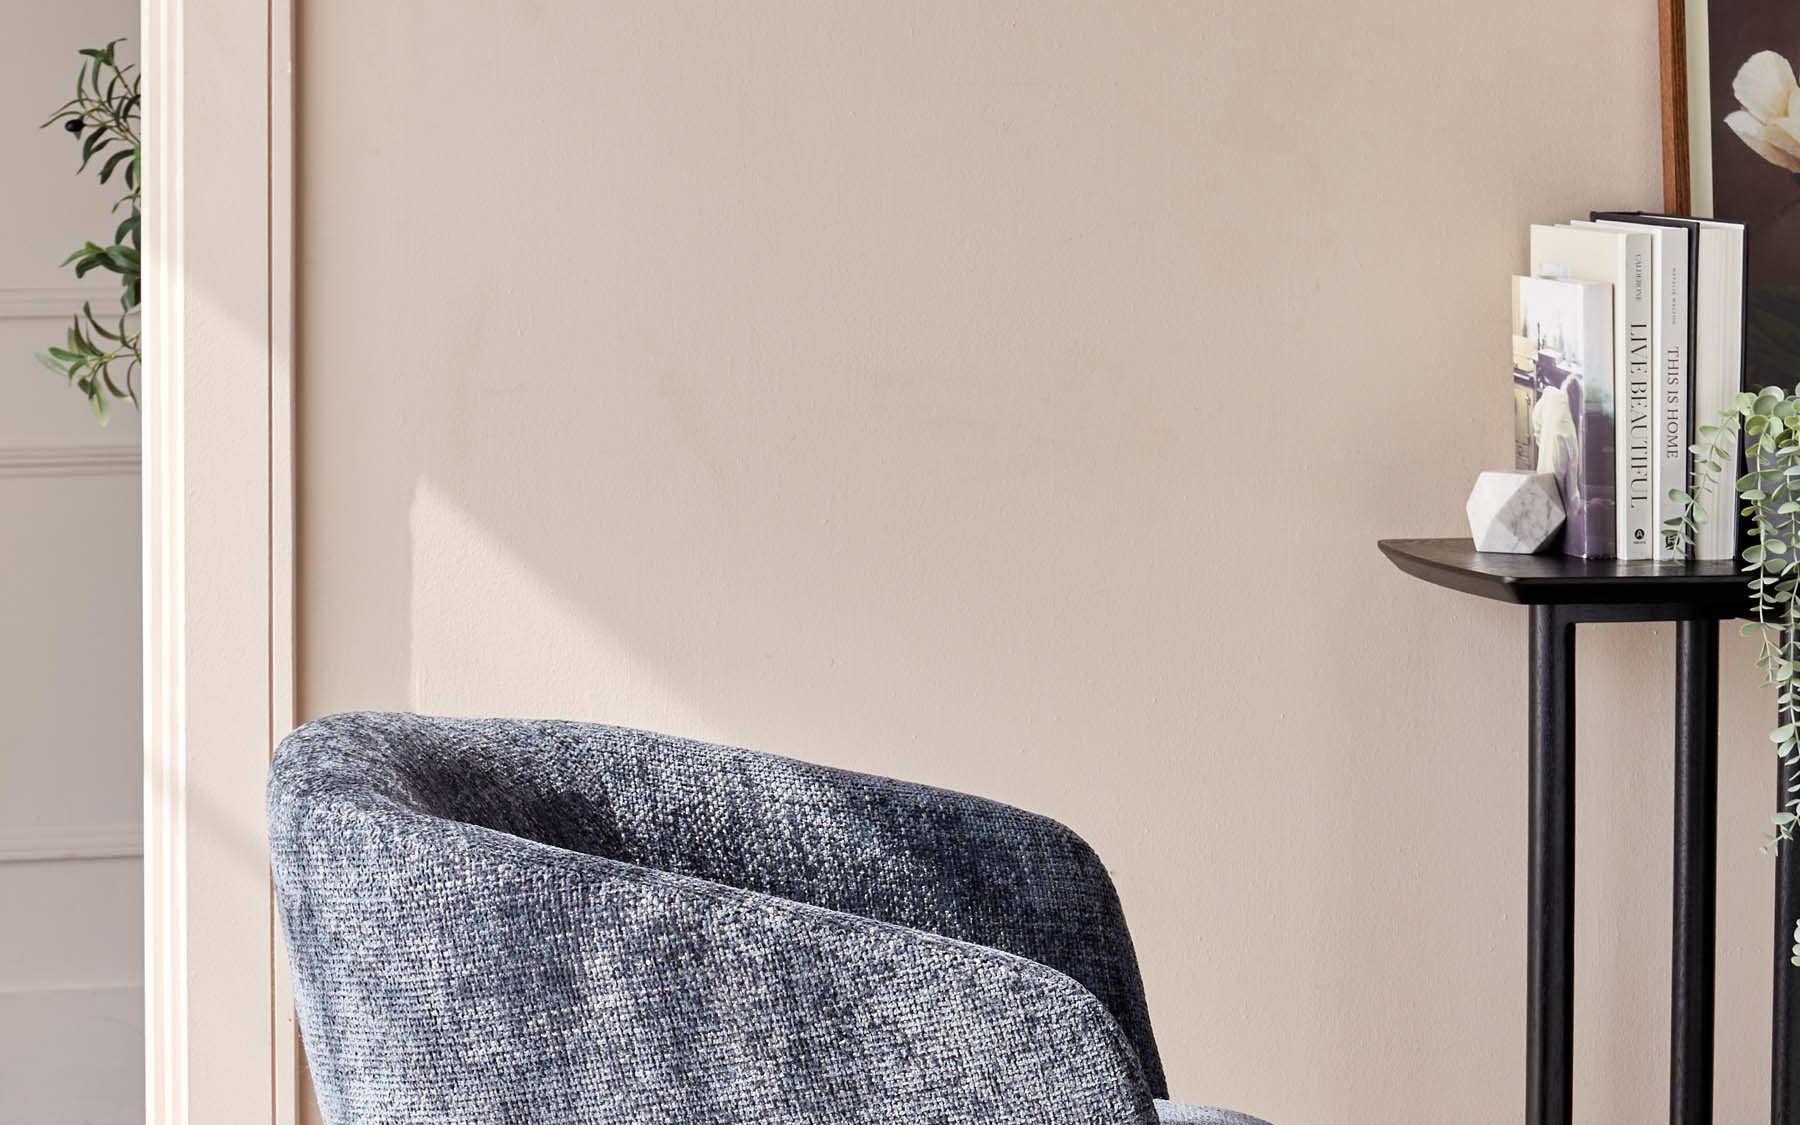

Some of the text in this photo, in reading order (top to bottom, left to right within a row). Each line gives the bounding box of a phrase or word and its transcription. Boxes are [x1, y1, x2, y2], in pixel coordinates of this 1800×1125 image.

[1630, 323, 1648, 509] LIVE BEAUTIFUL
[1666, 345, 1679, 459] THIS IS HOME
